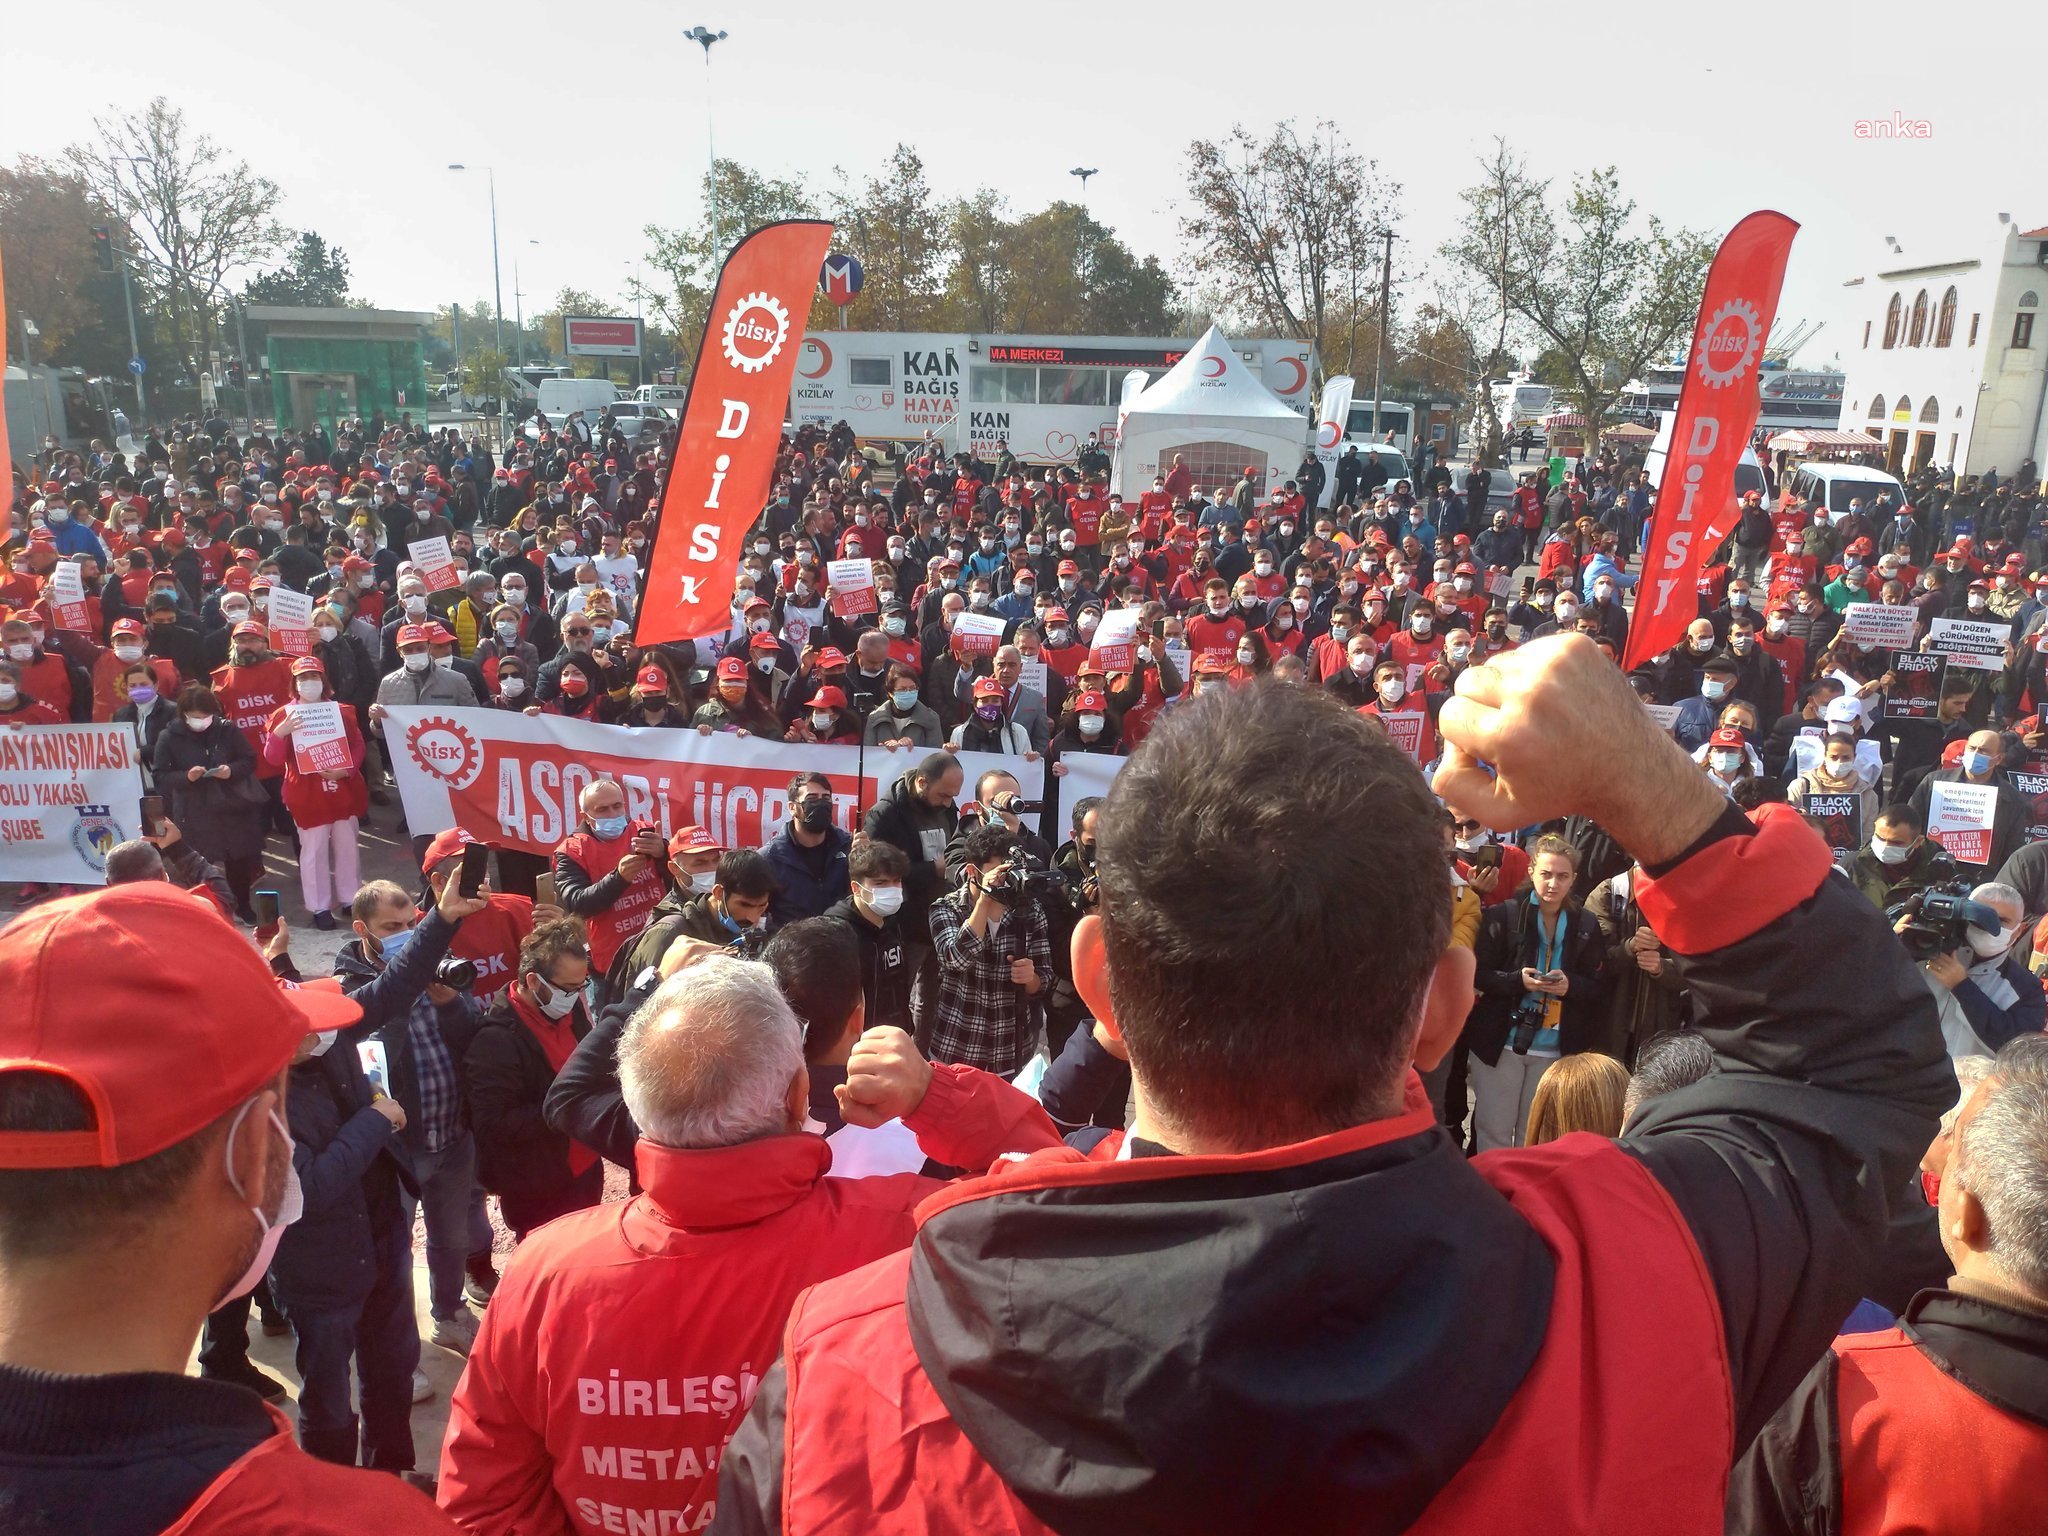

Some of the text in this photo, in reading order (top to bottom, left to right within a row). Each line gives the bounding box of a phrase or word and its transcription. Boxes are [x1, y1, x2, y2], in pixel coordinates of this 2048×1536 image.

[825, 261, 851, 293] M
[736, 318, 776, 343] DİSK
[1711, 330, 1747, 352] DİSK
[1010, 348, 1064, 361] MERKEZI
[797, 389, 834, 399] KIZILAY
[970, 412, 1009, 428] KAN
[1872, 607, 1886, 615] İÇİN
[1964, 624, 1991, 633] DÜZEN
[1937, 643, 1997, 654] DEĞİŞTİRELİM!
[1900, 654, 1938, 665] BLACK
[1897, 662, 1938, 672] FRIDAY
[238, 694, 276, 709] DİSK
[236, 713, 268, 729] GEN
[1388, 720, 1418, 735] ASGARİ
[0, 732, 130, 780] AYANIŞMASI
[420, 741, 461, 760] DİSK
[322, 779, 338, 792] İŞ
[2016, 775, 2048, 786] BLAC
[33, 784, 90, 806] YAKASI
[1811, 797, 1851, 806] BLACK
[1810, 806, 1852, 816] FRIDAY
[1943, 805, 1971, 813] savunmak
[1960, 815, 1983, 823] omuza!
[1, 819, 45, 845] ŞUBE
[1943, 833, 1959, 842] ARTIK
